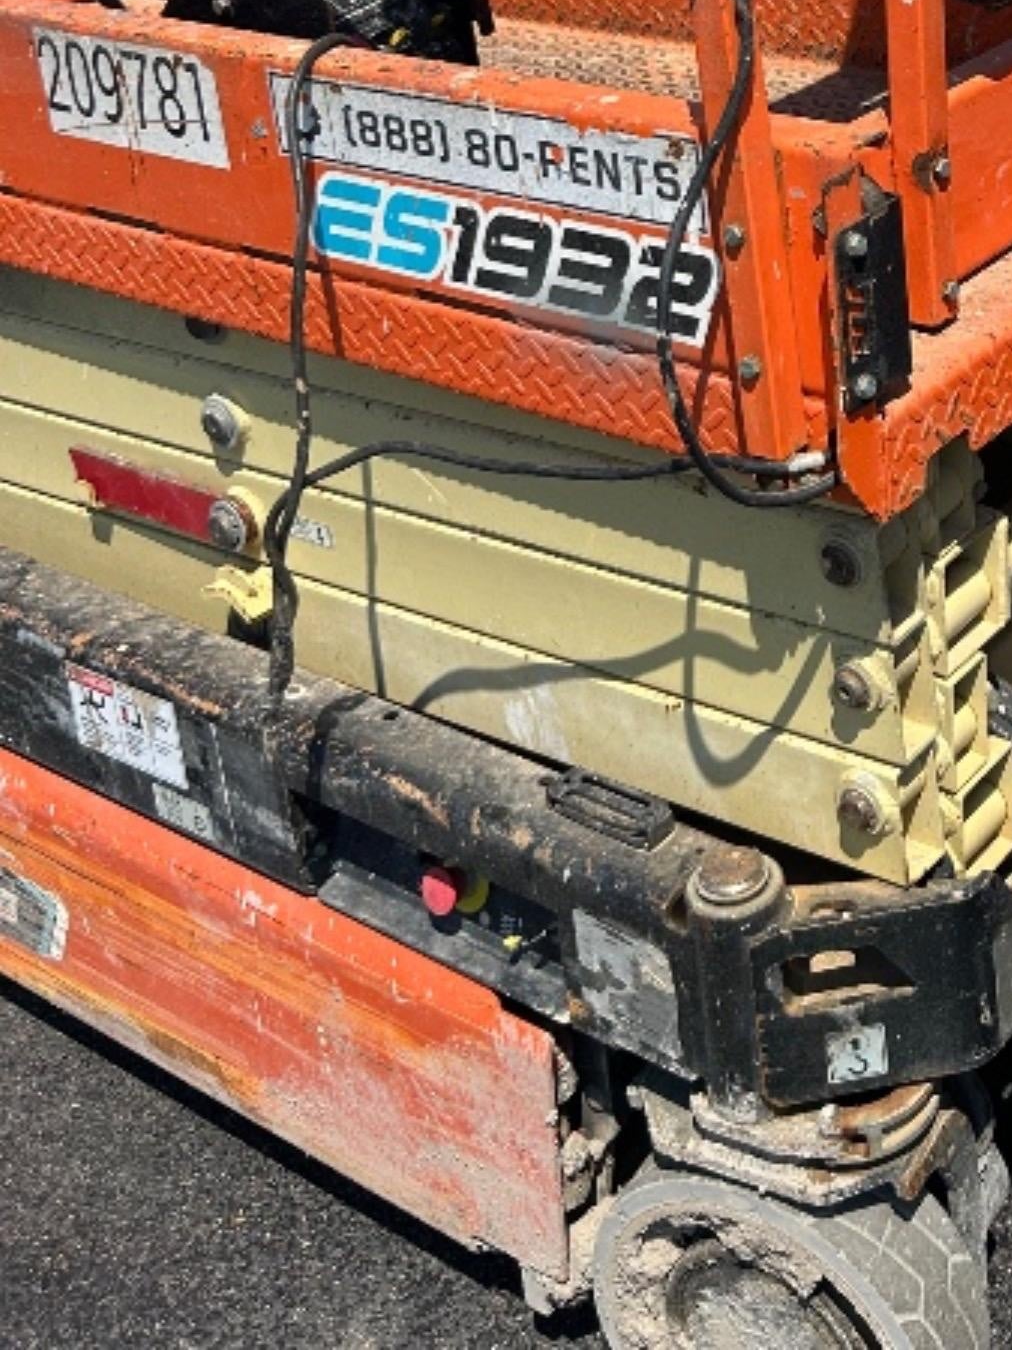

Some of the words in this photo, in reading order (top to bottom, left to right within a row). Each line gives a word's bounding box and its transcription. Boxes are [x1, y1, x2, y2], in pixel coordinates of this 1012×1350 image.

[36, 34, 211, 142] 209781
[343, 105, 450, 162] (888)
[315, 175, 717, 343] ES1932
